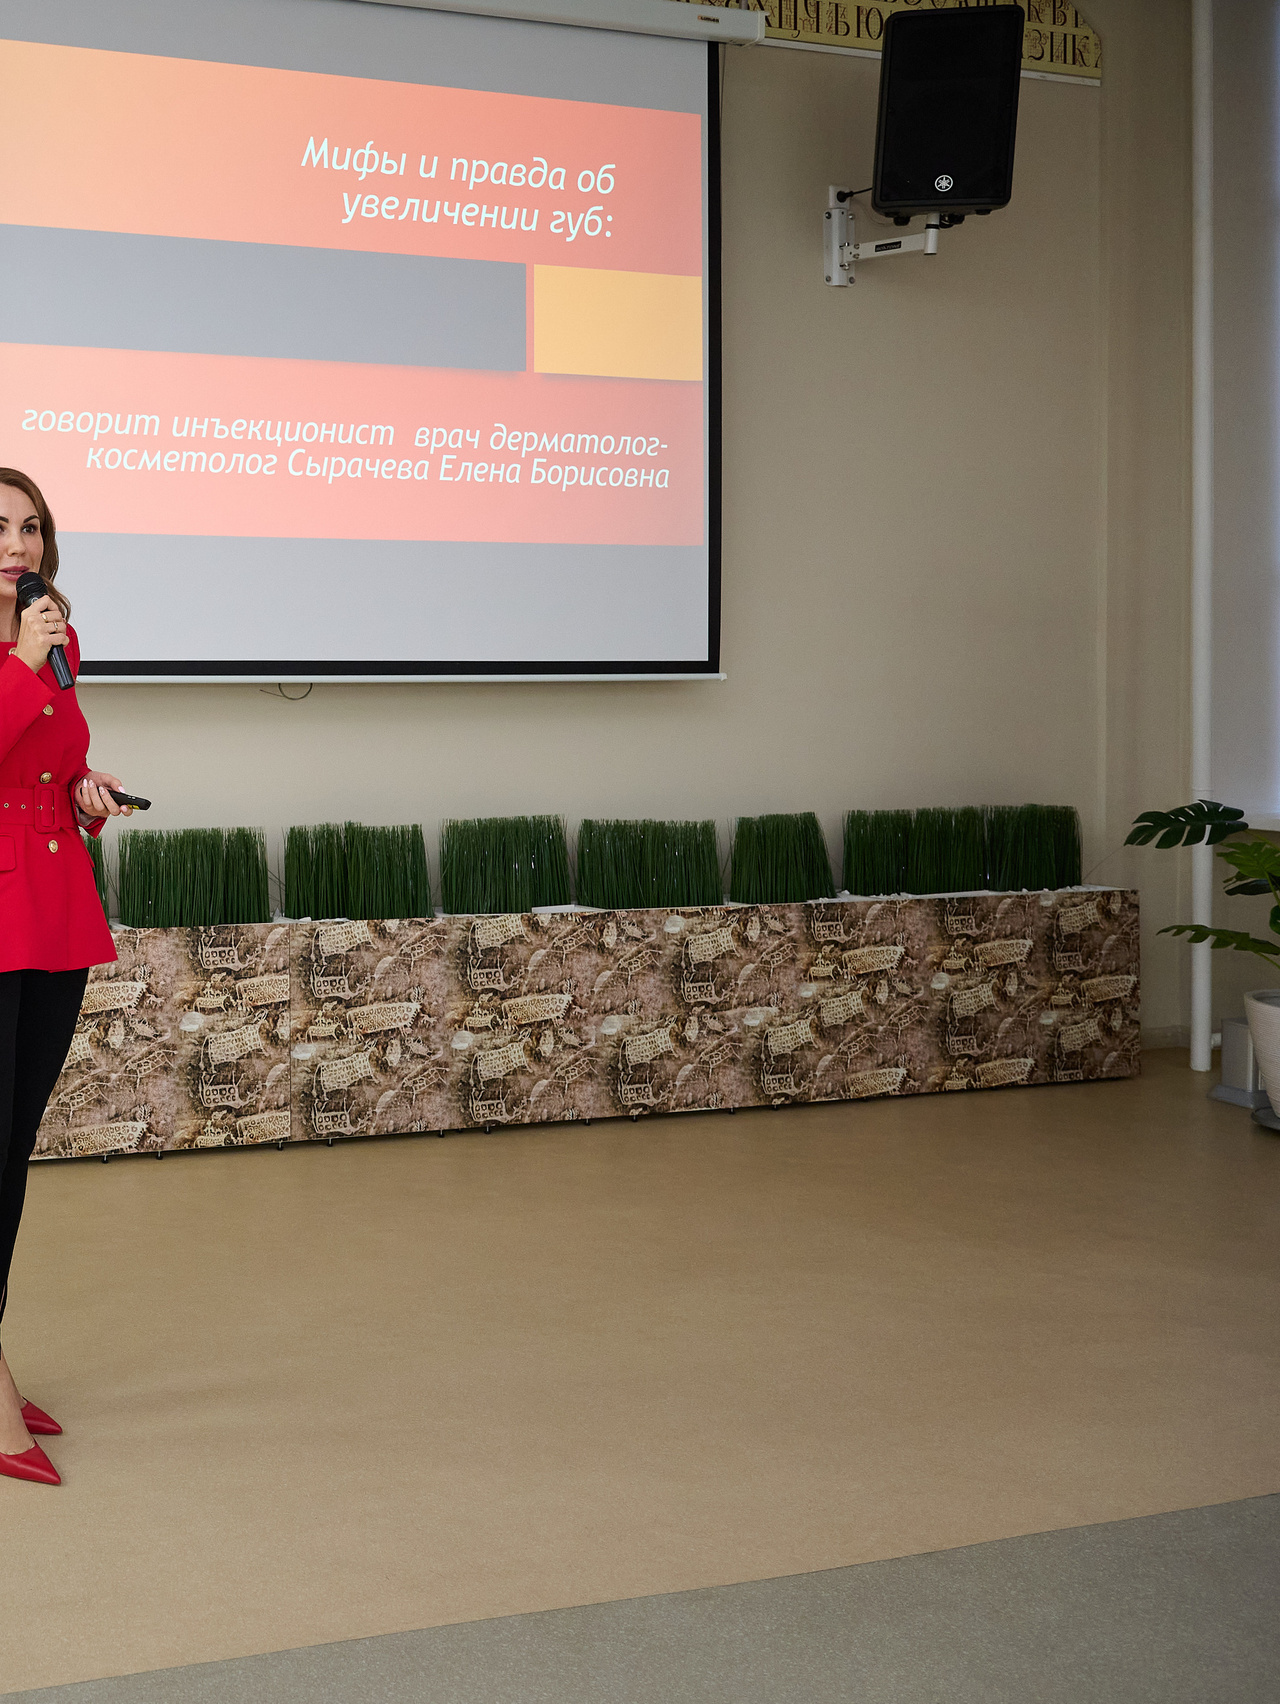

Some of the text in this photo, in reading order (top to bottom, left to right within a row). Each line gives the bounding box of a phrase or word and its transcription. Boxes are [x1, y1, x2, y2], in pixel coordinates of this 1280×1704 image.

[301, 136, 616, 195] Мифы и правда об
[342, 192, 613, 242] увеличении губ:
[21, 409, 668, 458] говорит инъекционист врач дерматолог-
[86, 447, 669, 492] косметолог Сырачева Елена Борисовна
